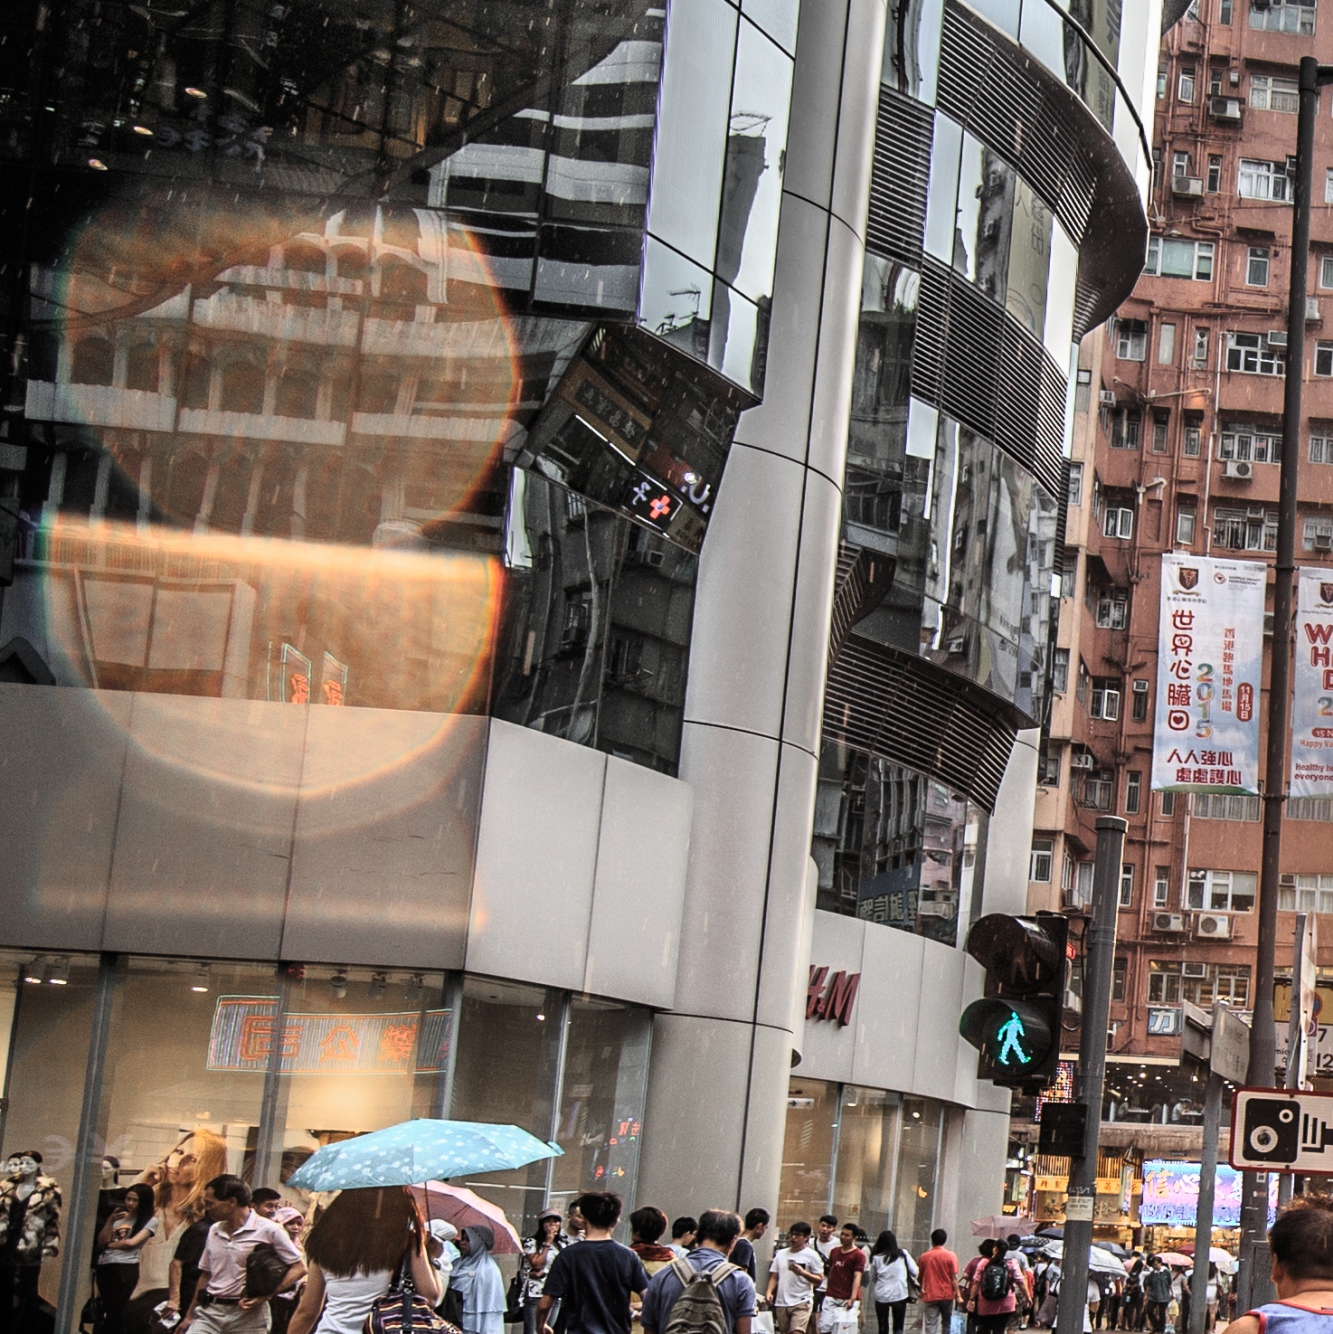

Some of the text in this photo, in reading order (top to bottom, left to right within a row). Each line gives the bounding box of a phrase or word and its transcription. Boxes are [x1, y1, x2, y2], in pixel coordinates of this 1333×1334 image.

[1167, 609, 1195, 731] 世界心臟日
[1195, 663, 1214, 738] 2015
[1300, 739, 1323, 750] Happy
[1167, 749, 1233, 766] 人人強心
[1175, 767, 1242, 785] 處處護心
[1295, 763, 1331, 774] Healthy
